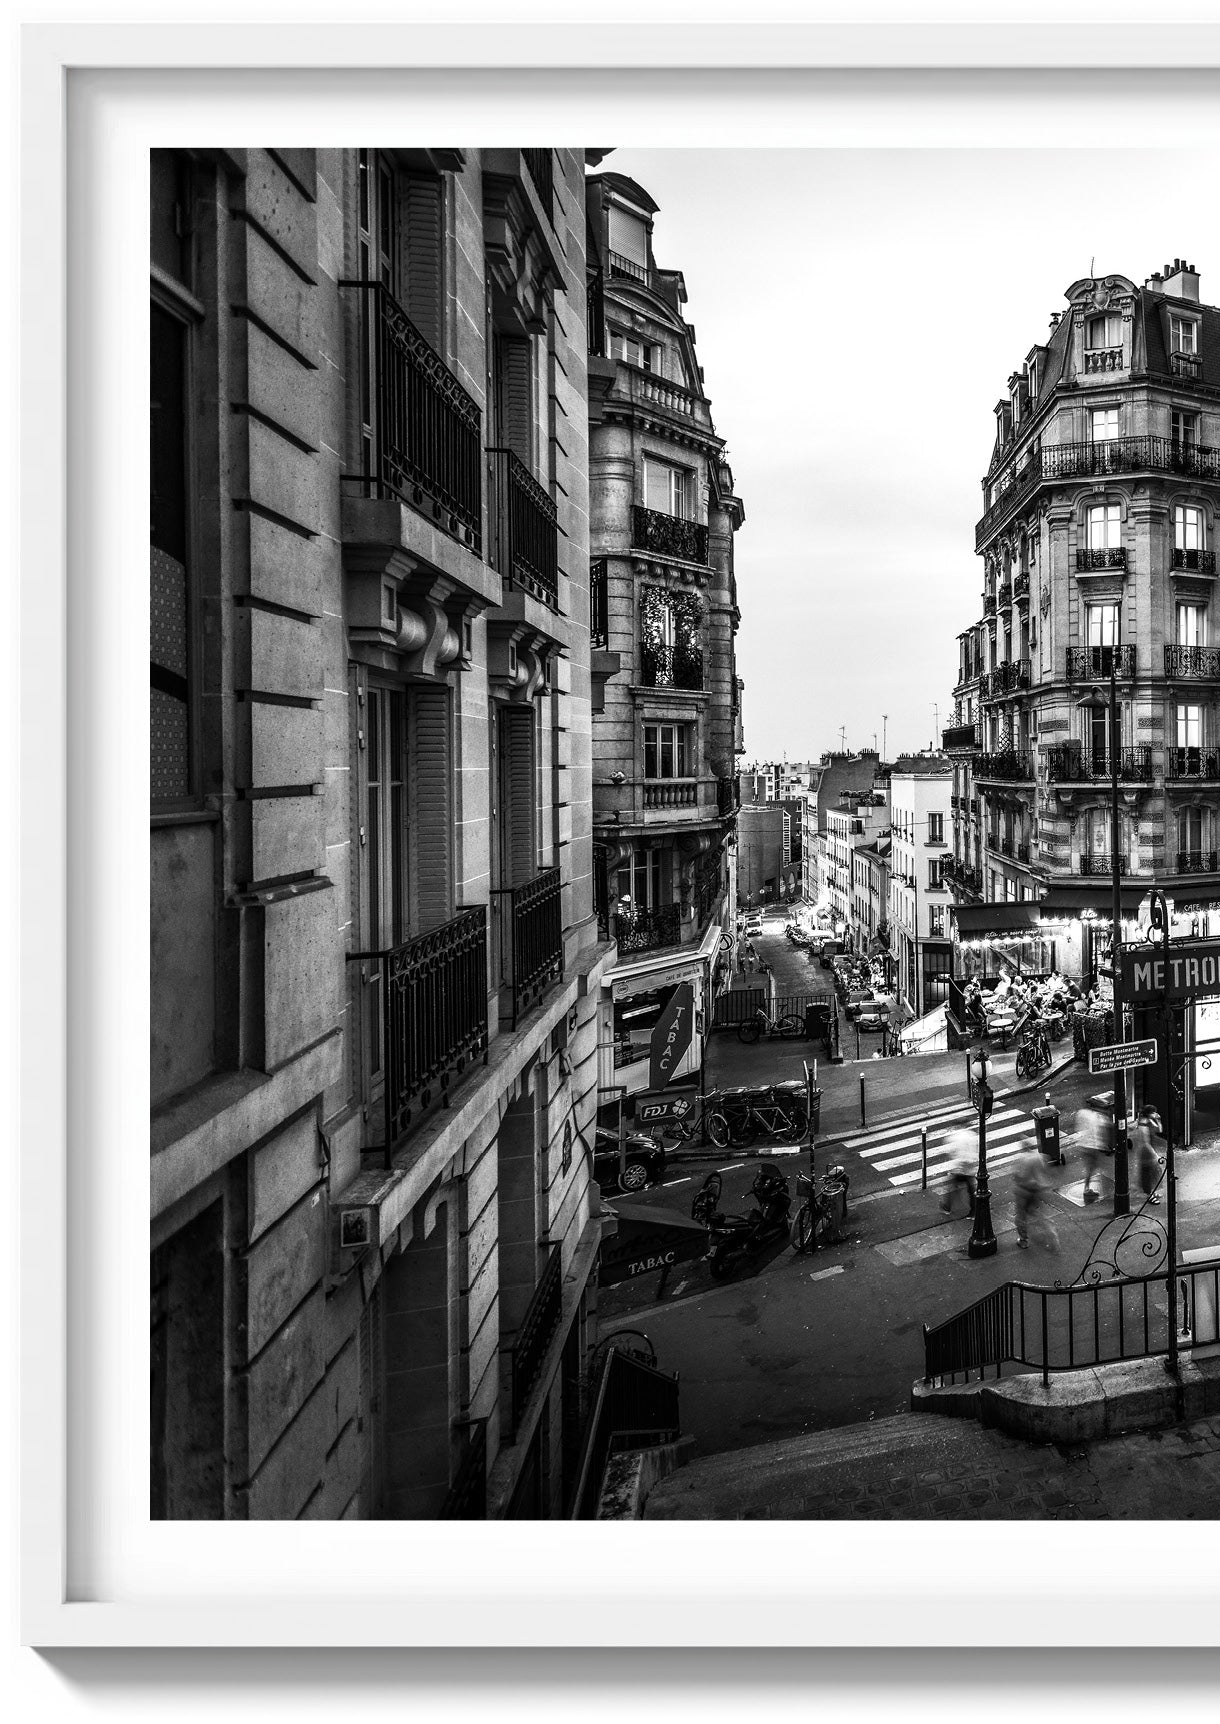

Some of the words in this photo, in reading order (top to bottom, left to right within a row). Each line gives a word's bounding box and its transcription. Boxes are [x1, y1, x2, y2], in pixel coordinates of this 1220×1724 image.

[660, 1006, 685, 1069] TABAC
[1113, 1046, 1139, 1054] Montmartre
[1116, 1052, 1141, 1060] Montmartre
[644, 1104, 668, 1118] FDJ
[628, 1251, 675, 1275] TABAC
